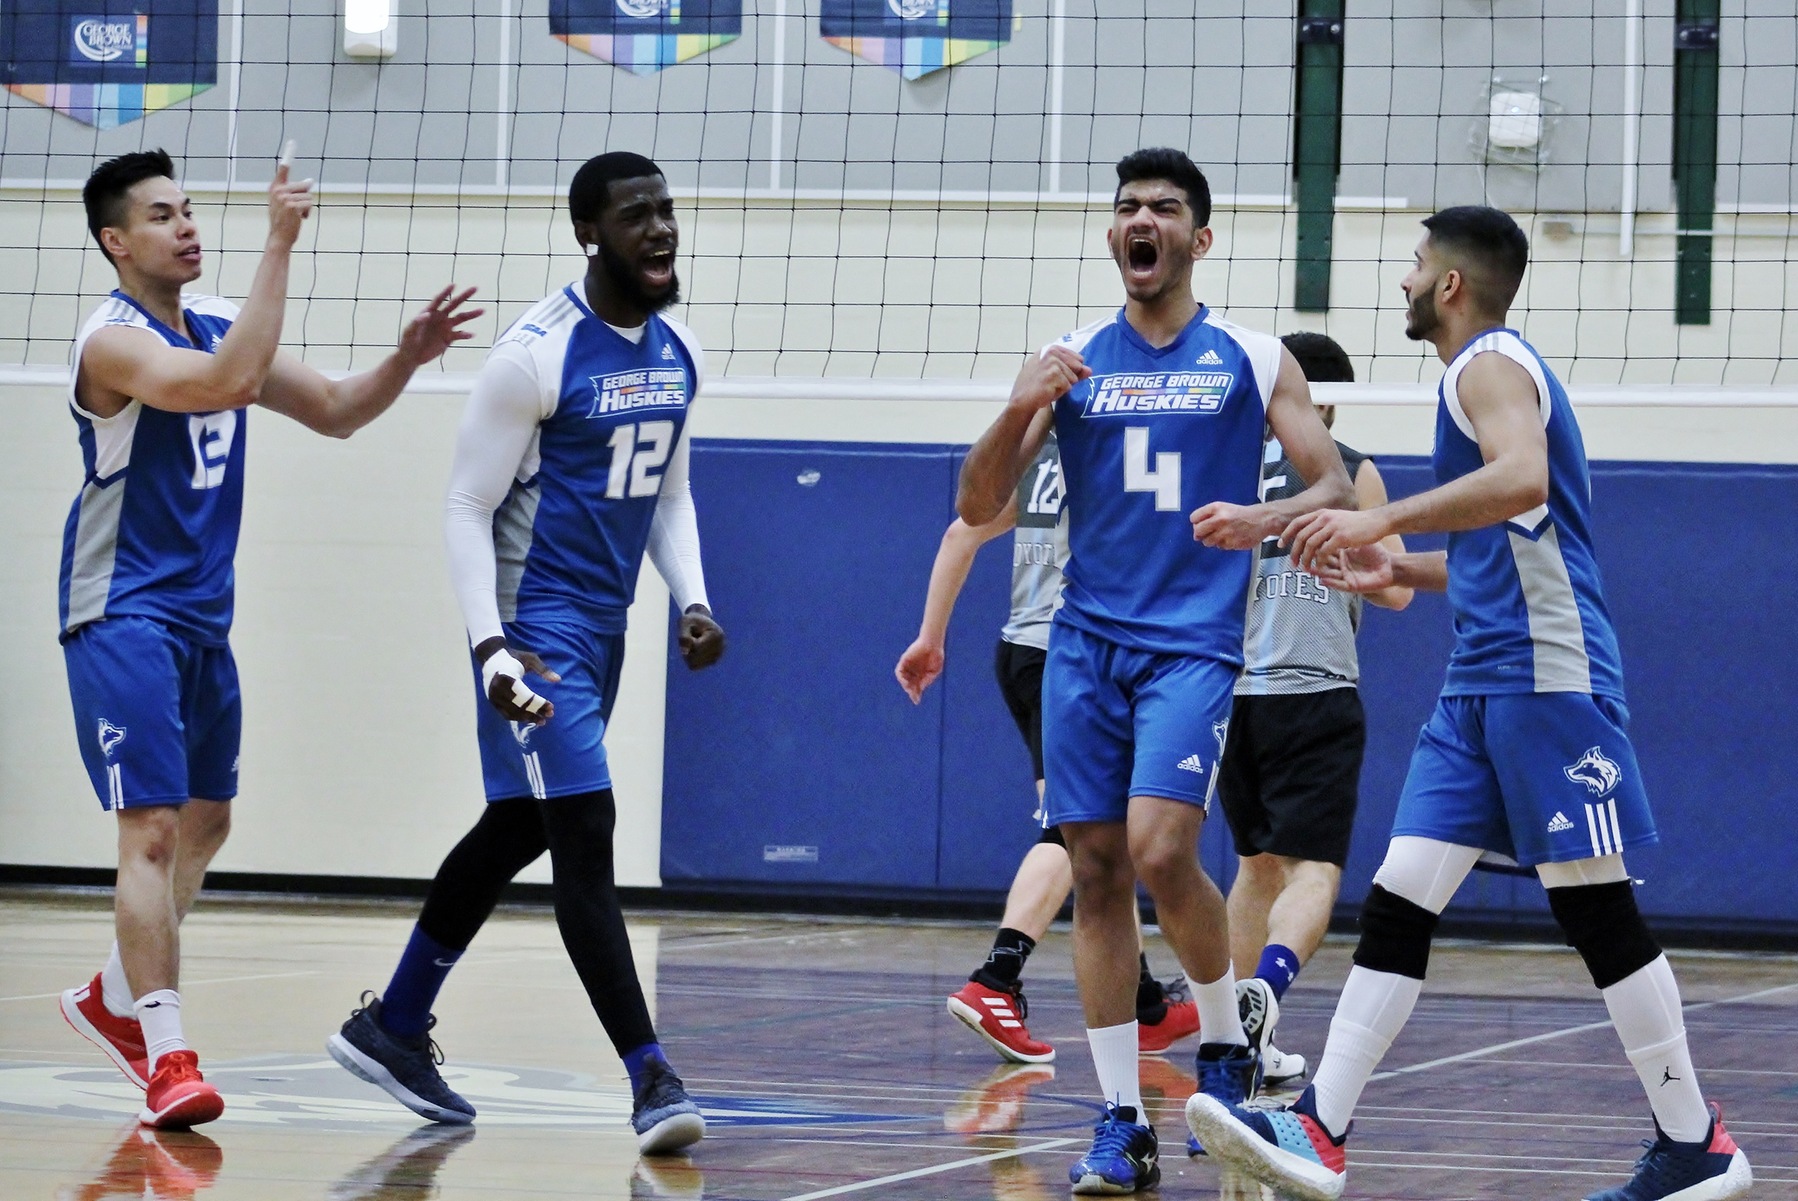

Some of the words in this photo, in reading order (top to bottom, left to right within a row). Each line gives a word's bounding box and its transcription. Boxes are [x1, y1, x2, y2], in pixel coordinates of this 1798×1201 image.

[83, 24, 131, 37] GEORGE
[89, 34, 132, 47] BROWN
[602, 372, 647, 391] GEORGE
[648, 371, 684, 384] BROWN
[1100, 375, 1165, 390] GEORGE
[1166, 374, 1229, 388] BROWN
[604, 419, 675, 499] 12
[1124, 427, 1181, 511] 4
[1027, 458, 1059, 514] 12
[1177, 763, 1203, 774] adidas
[1547, 821, 1574, 833] adidas
